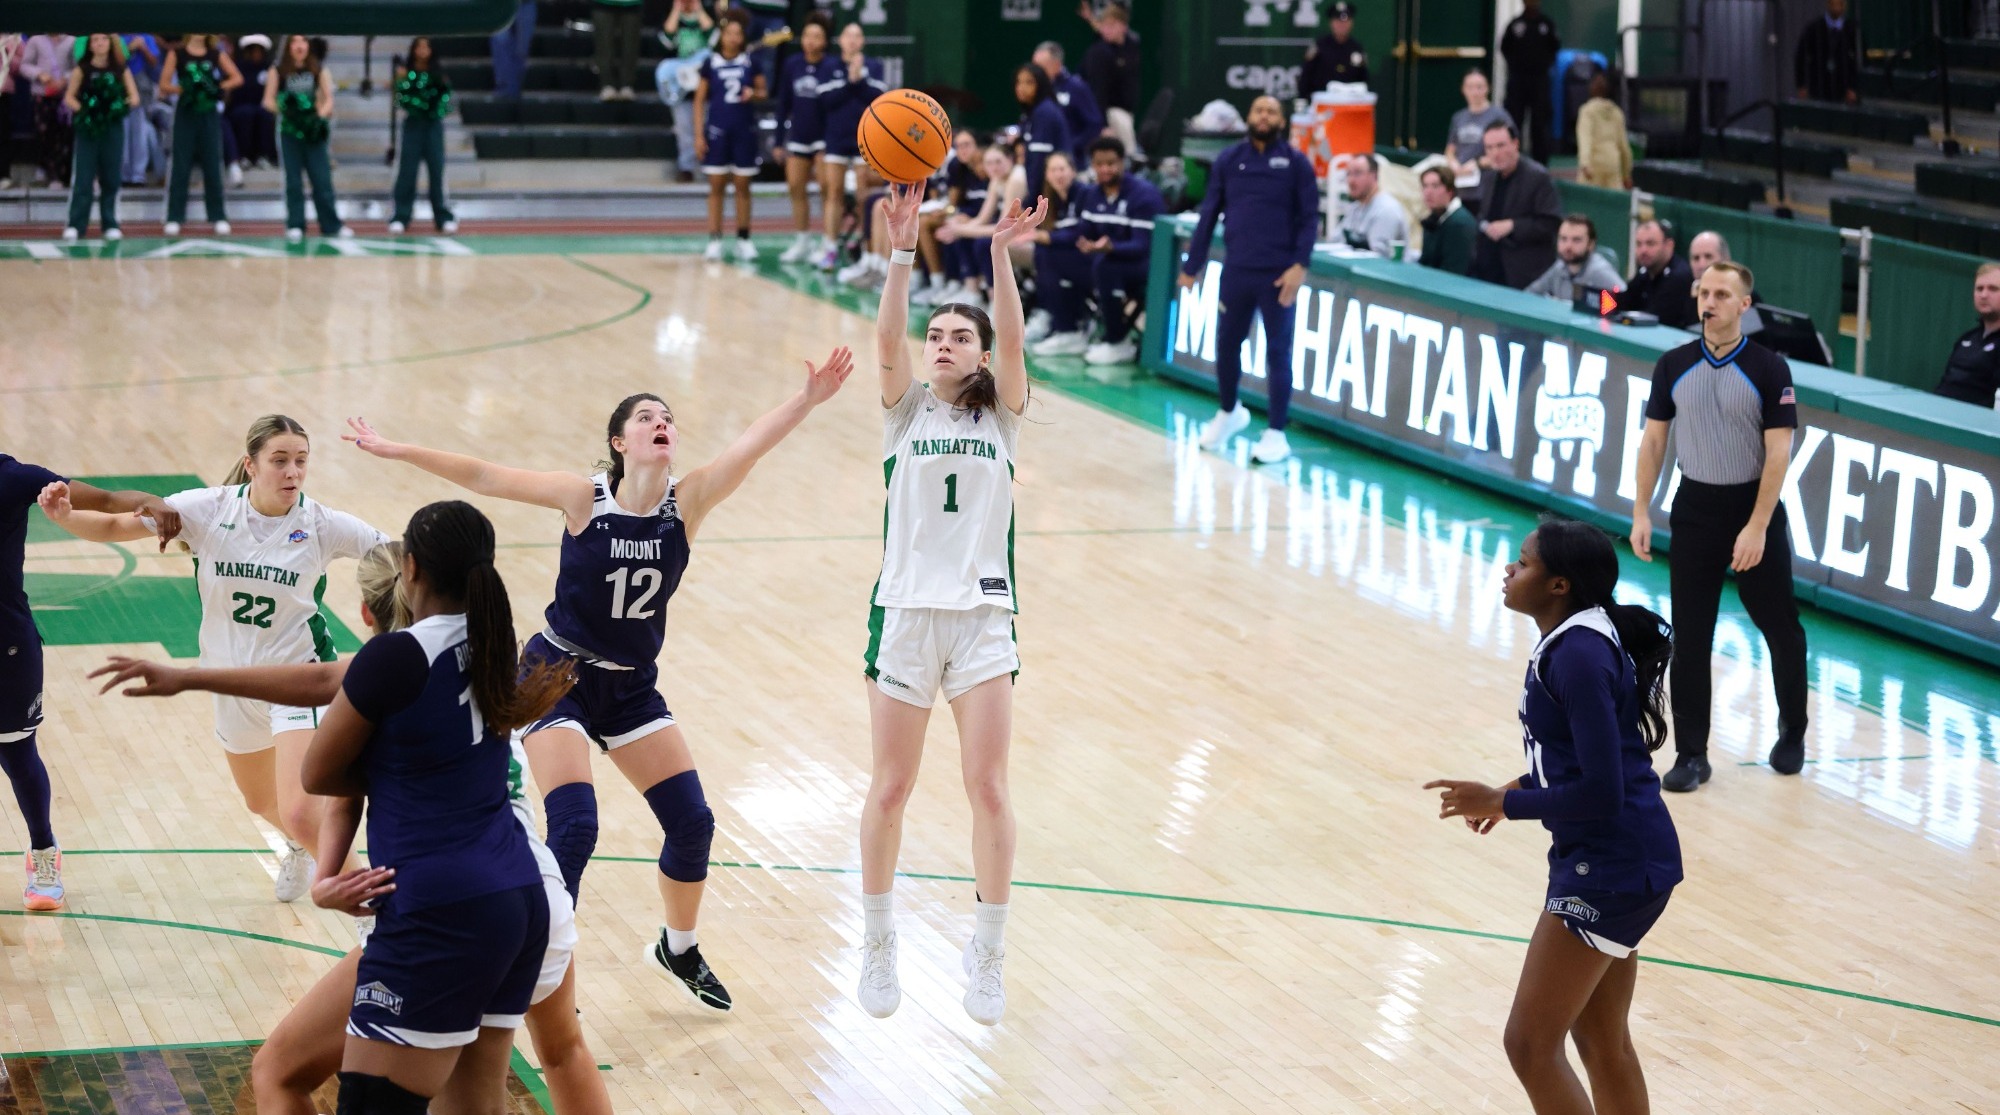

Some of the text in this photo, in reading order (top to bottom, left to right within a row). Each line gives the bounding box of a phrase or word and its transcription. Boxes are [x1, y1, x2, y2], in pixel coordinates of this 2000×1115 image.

[723, 79, 742, 104] 2
[912, 438, 997, 460] MANHATTAN
[943, 473, 959, 513] 1
[610, 538, 663, 560] MOUNT
[215, 561, 300, 587] MANHATTAN
[605, 567, 664, 620] 12
[232, 591, 276, 629] 22
[1565, 902, 1598, 922] MOUNT
[371, 989, 401, 1011] MOUNT
